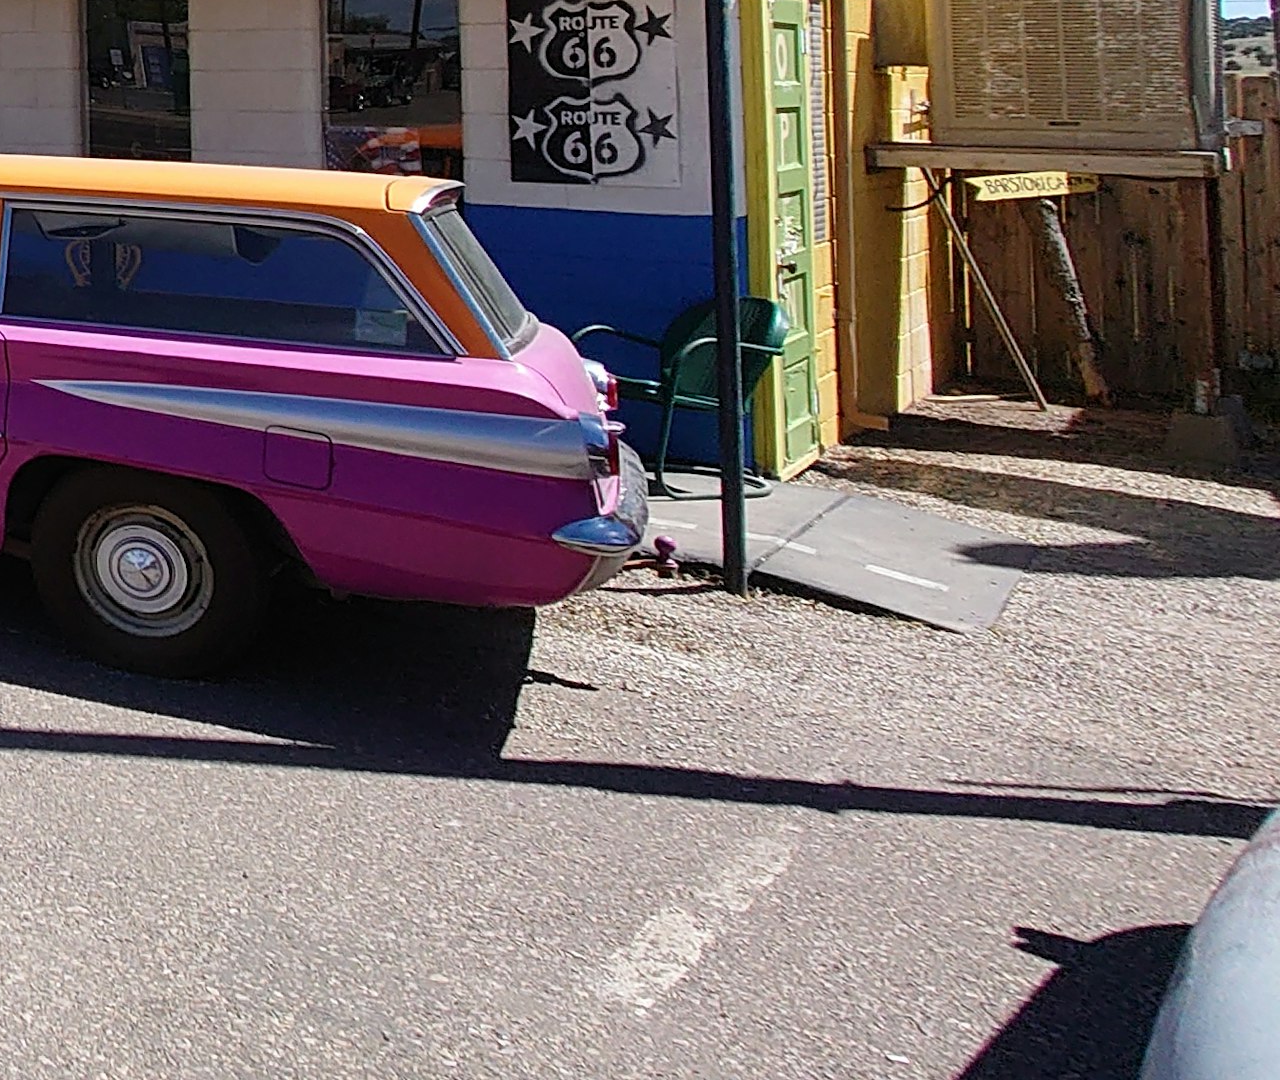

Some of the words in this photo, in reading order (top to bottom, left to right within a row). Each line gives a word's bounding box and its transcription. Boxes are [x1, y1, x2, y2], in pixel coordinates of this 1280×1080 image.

[558, 15, 619, 31] ROUTE
[562, 36, 617, 70] 66
[561, 110, 621, 126] ROUTE
[563, 131, 619, 165] 66
